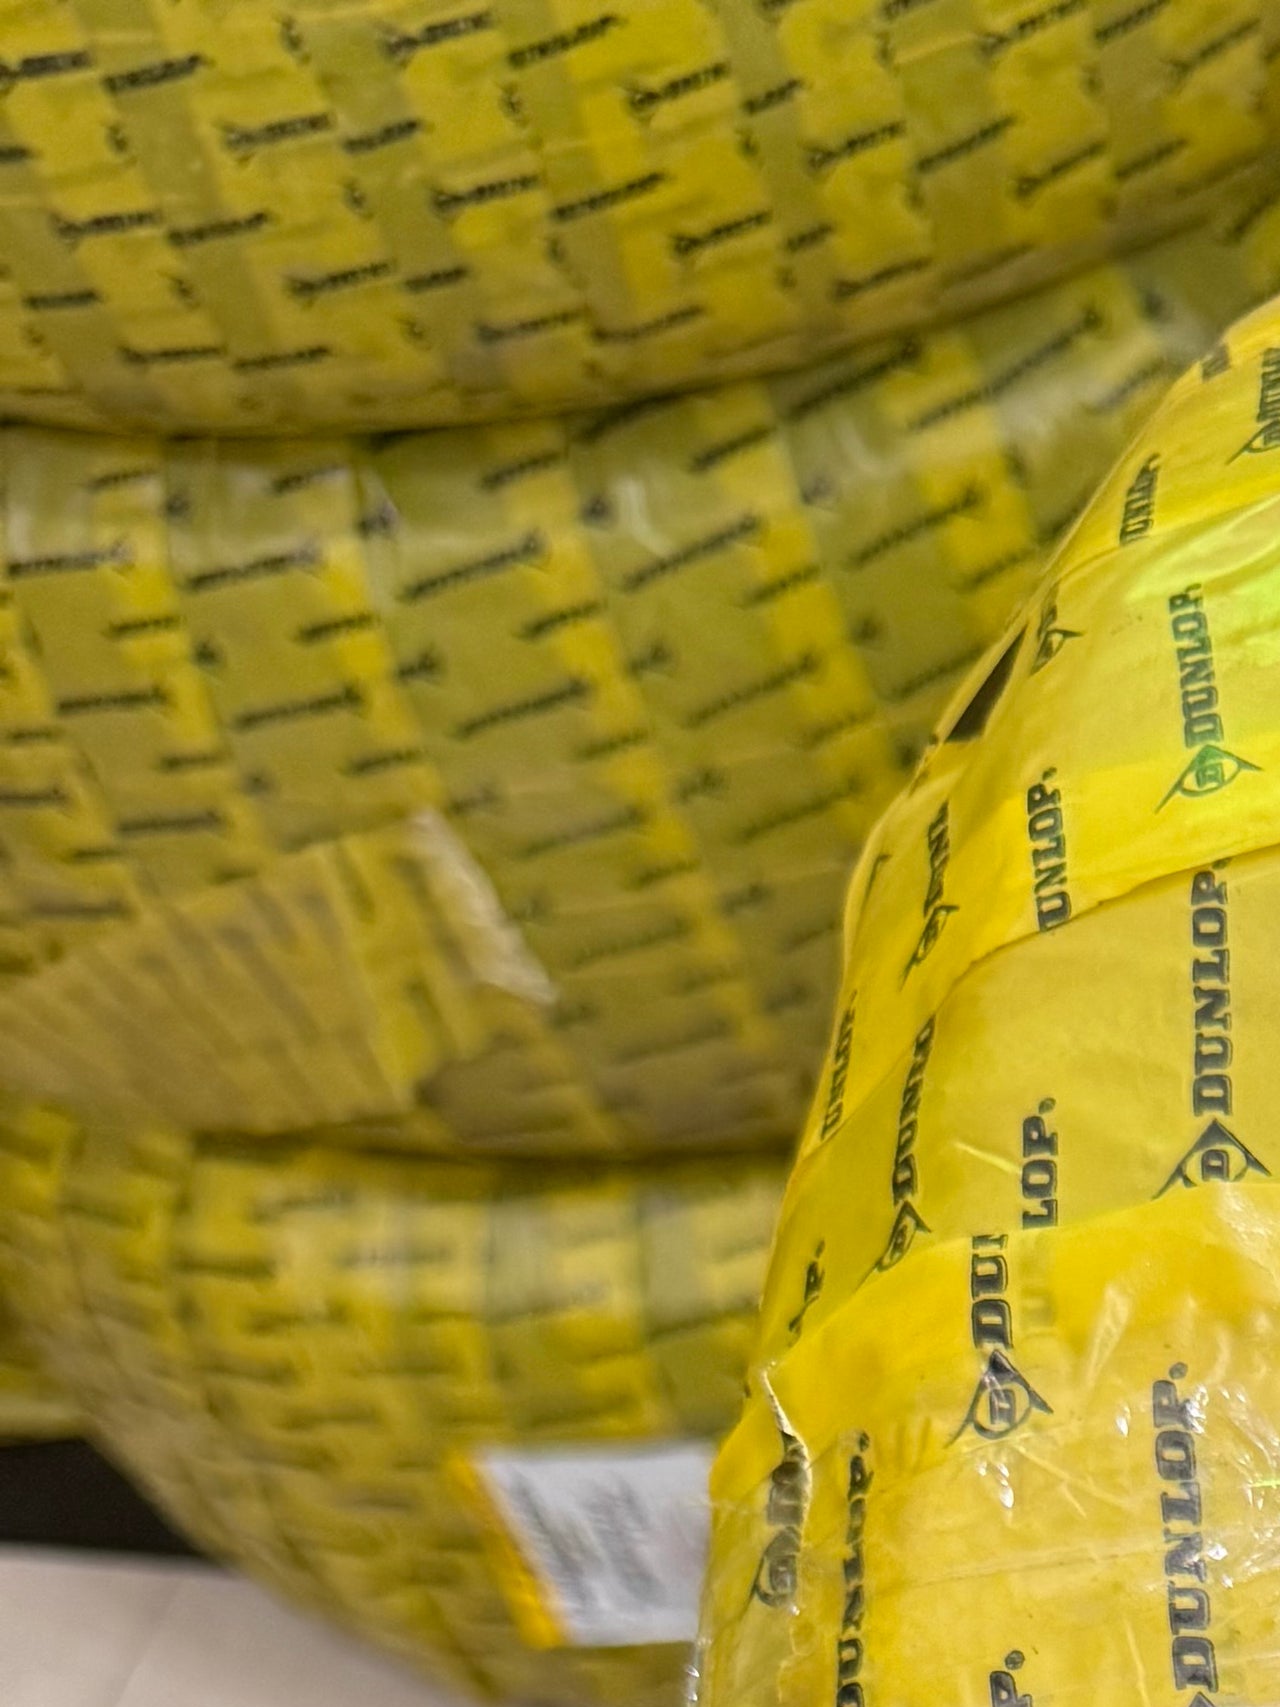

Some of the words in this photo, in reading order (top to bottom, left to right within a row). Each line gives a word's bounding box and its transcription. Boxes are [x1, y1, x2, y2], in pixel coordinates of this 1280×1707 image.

[1168, 585, 1224, 747] DUNLOP
[1190, 856, 1233, 1116] DUNLOP
[1152, 1363, 1219, 1692] DUNLOP
